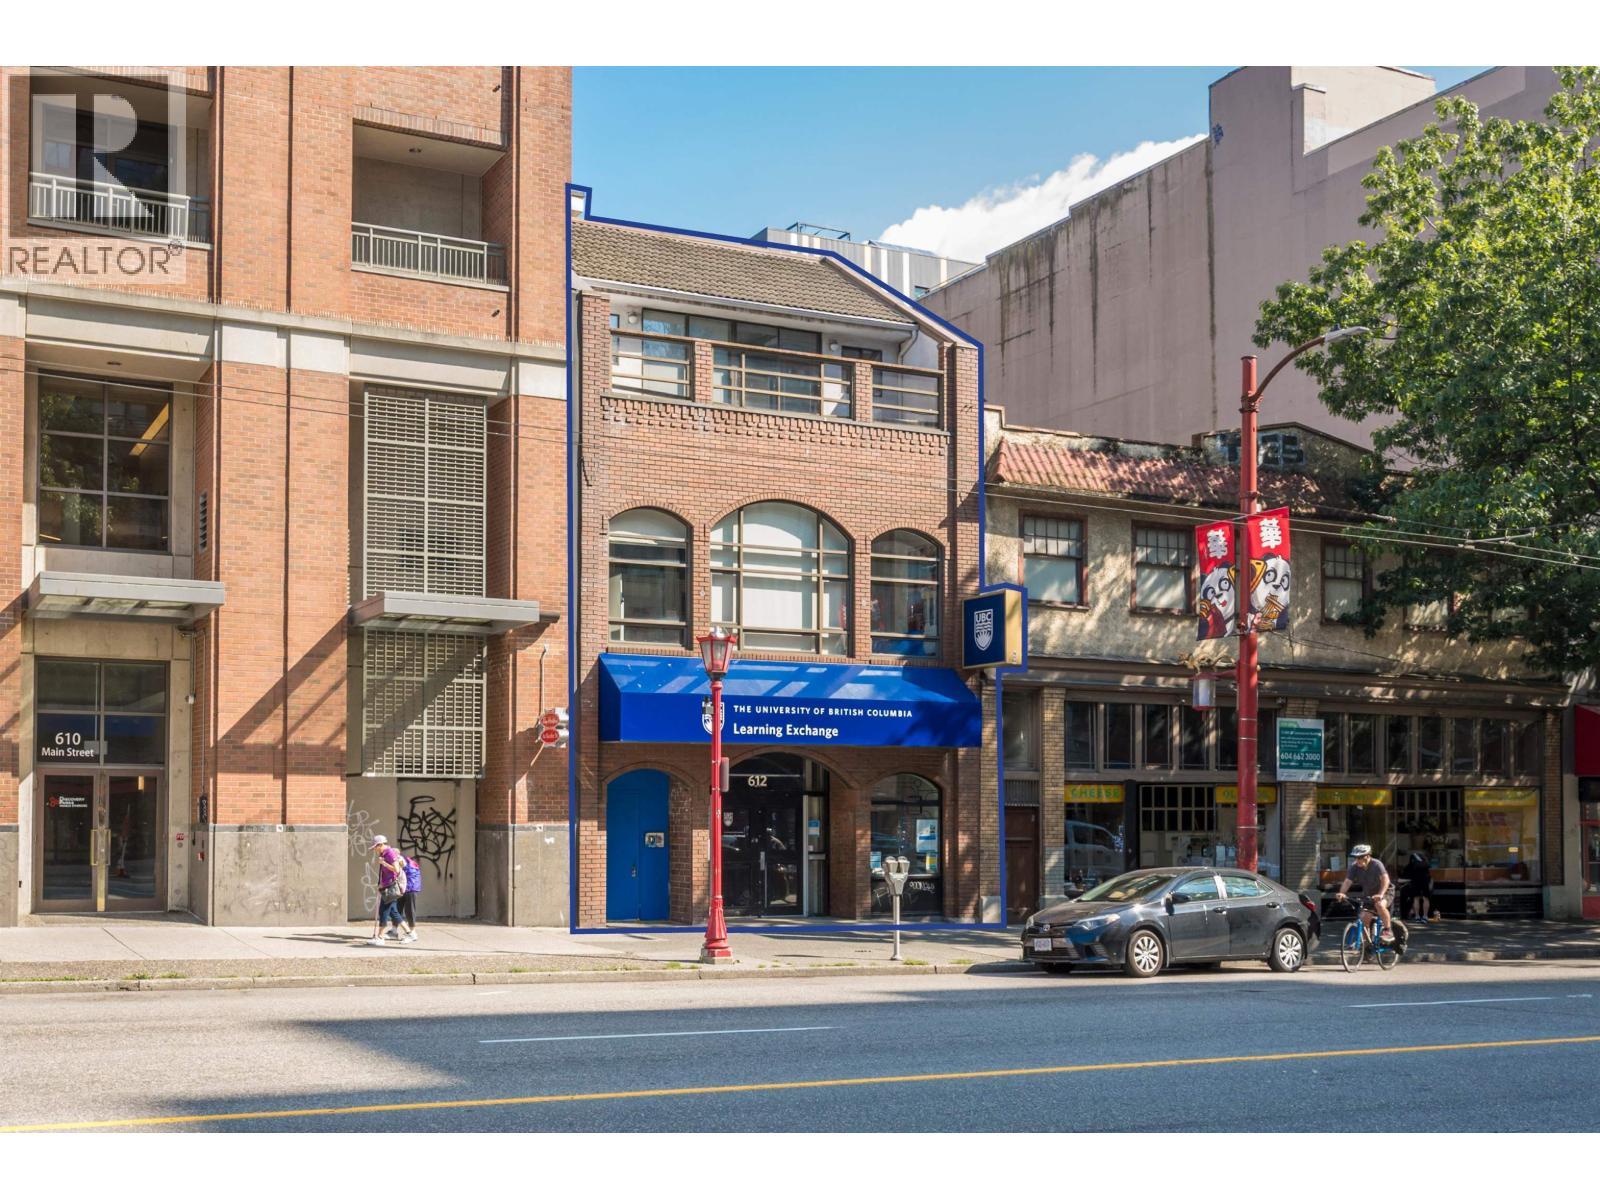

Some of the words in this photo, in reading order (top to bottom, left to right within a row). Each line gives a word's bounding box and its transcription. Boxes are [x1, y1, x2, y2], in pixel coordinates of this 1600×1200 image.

[975, 611, 992, 623] UBC
[733, 705, 751, 713] THE
[755, 706, 811, 715] UNIVERSITY
[828, 708, 864, 717] BRITISH
[866, 709, 913, 718] COLUMBIA
[733, 723, 783, 738] Learning
[786, 724, 839, 739] Exchange
[55, 732, 81, 745] 610
[41, 747, 65, 757] Main
[66, 748, 94, 757] Street
[748, 775, 767, 787] 612
